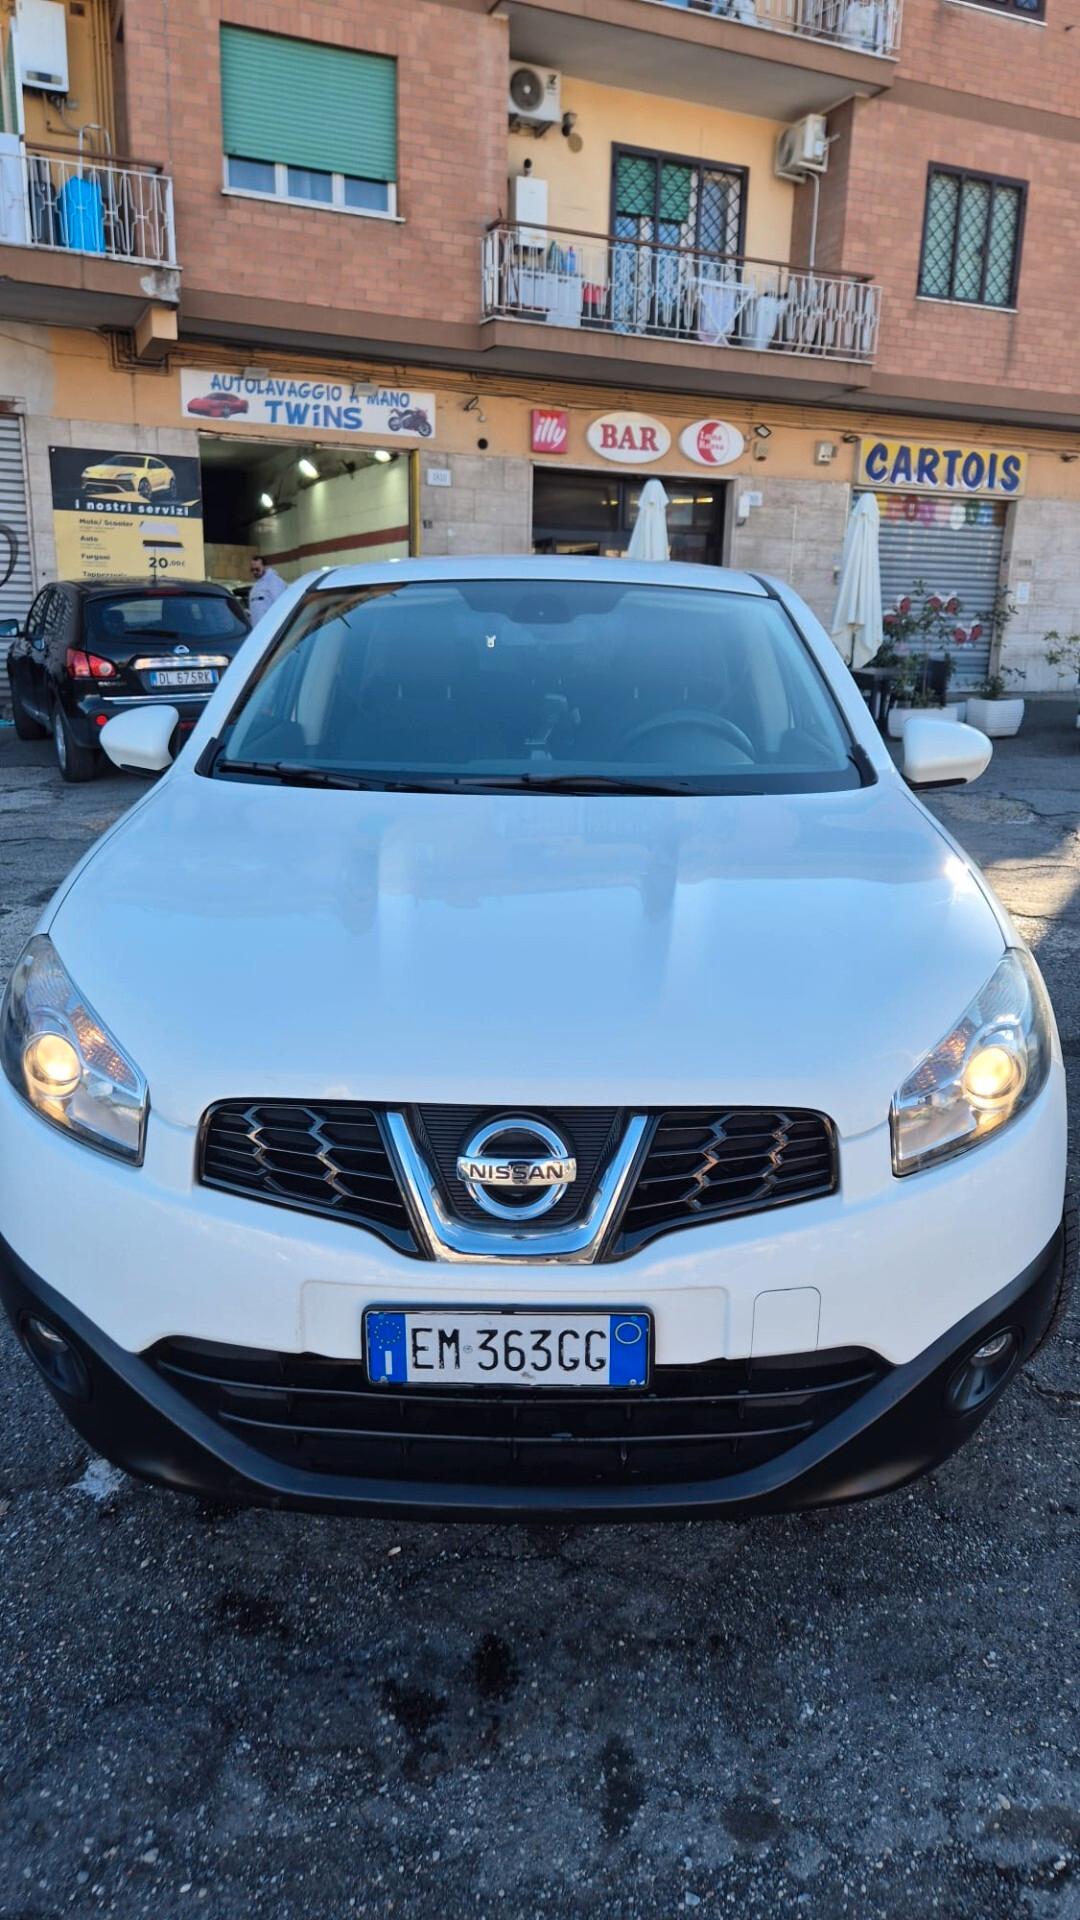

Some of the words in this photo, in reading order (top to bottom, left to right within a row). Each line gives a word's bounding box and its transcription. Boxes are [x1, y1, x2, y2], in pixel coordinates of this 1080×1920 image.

[210, 374, 342, 402] AUTOLAVAGGIO
[534, 417, 566, 448] illy
[600, 424, 659, 451] BAR
[865, 443, 1021, 492] CARTOIS
[86, 502, 132, 513] nostri
[138, 505, 189, 517] servizi
[469, 1163, 564, 1180] NISSAN
[410, 1327, 461, 1370] EM
[476, 1328, 607, 1372] 363GG
